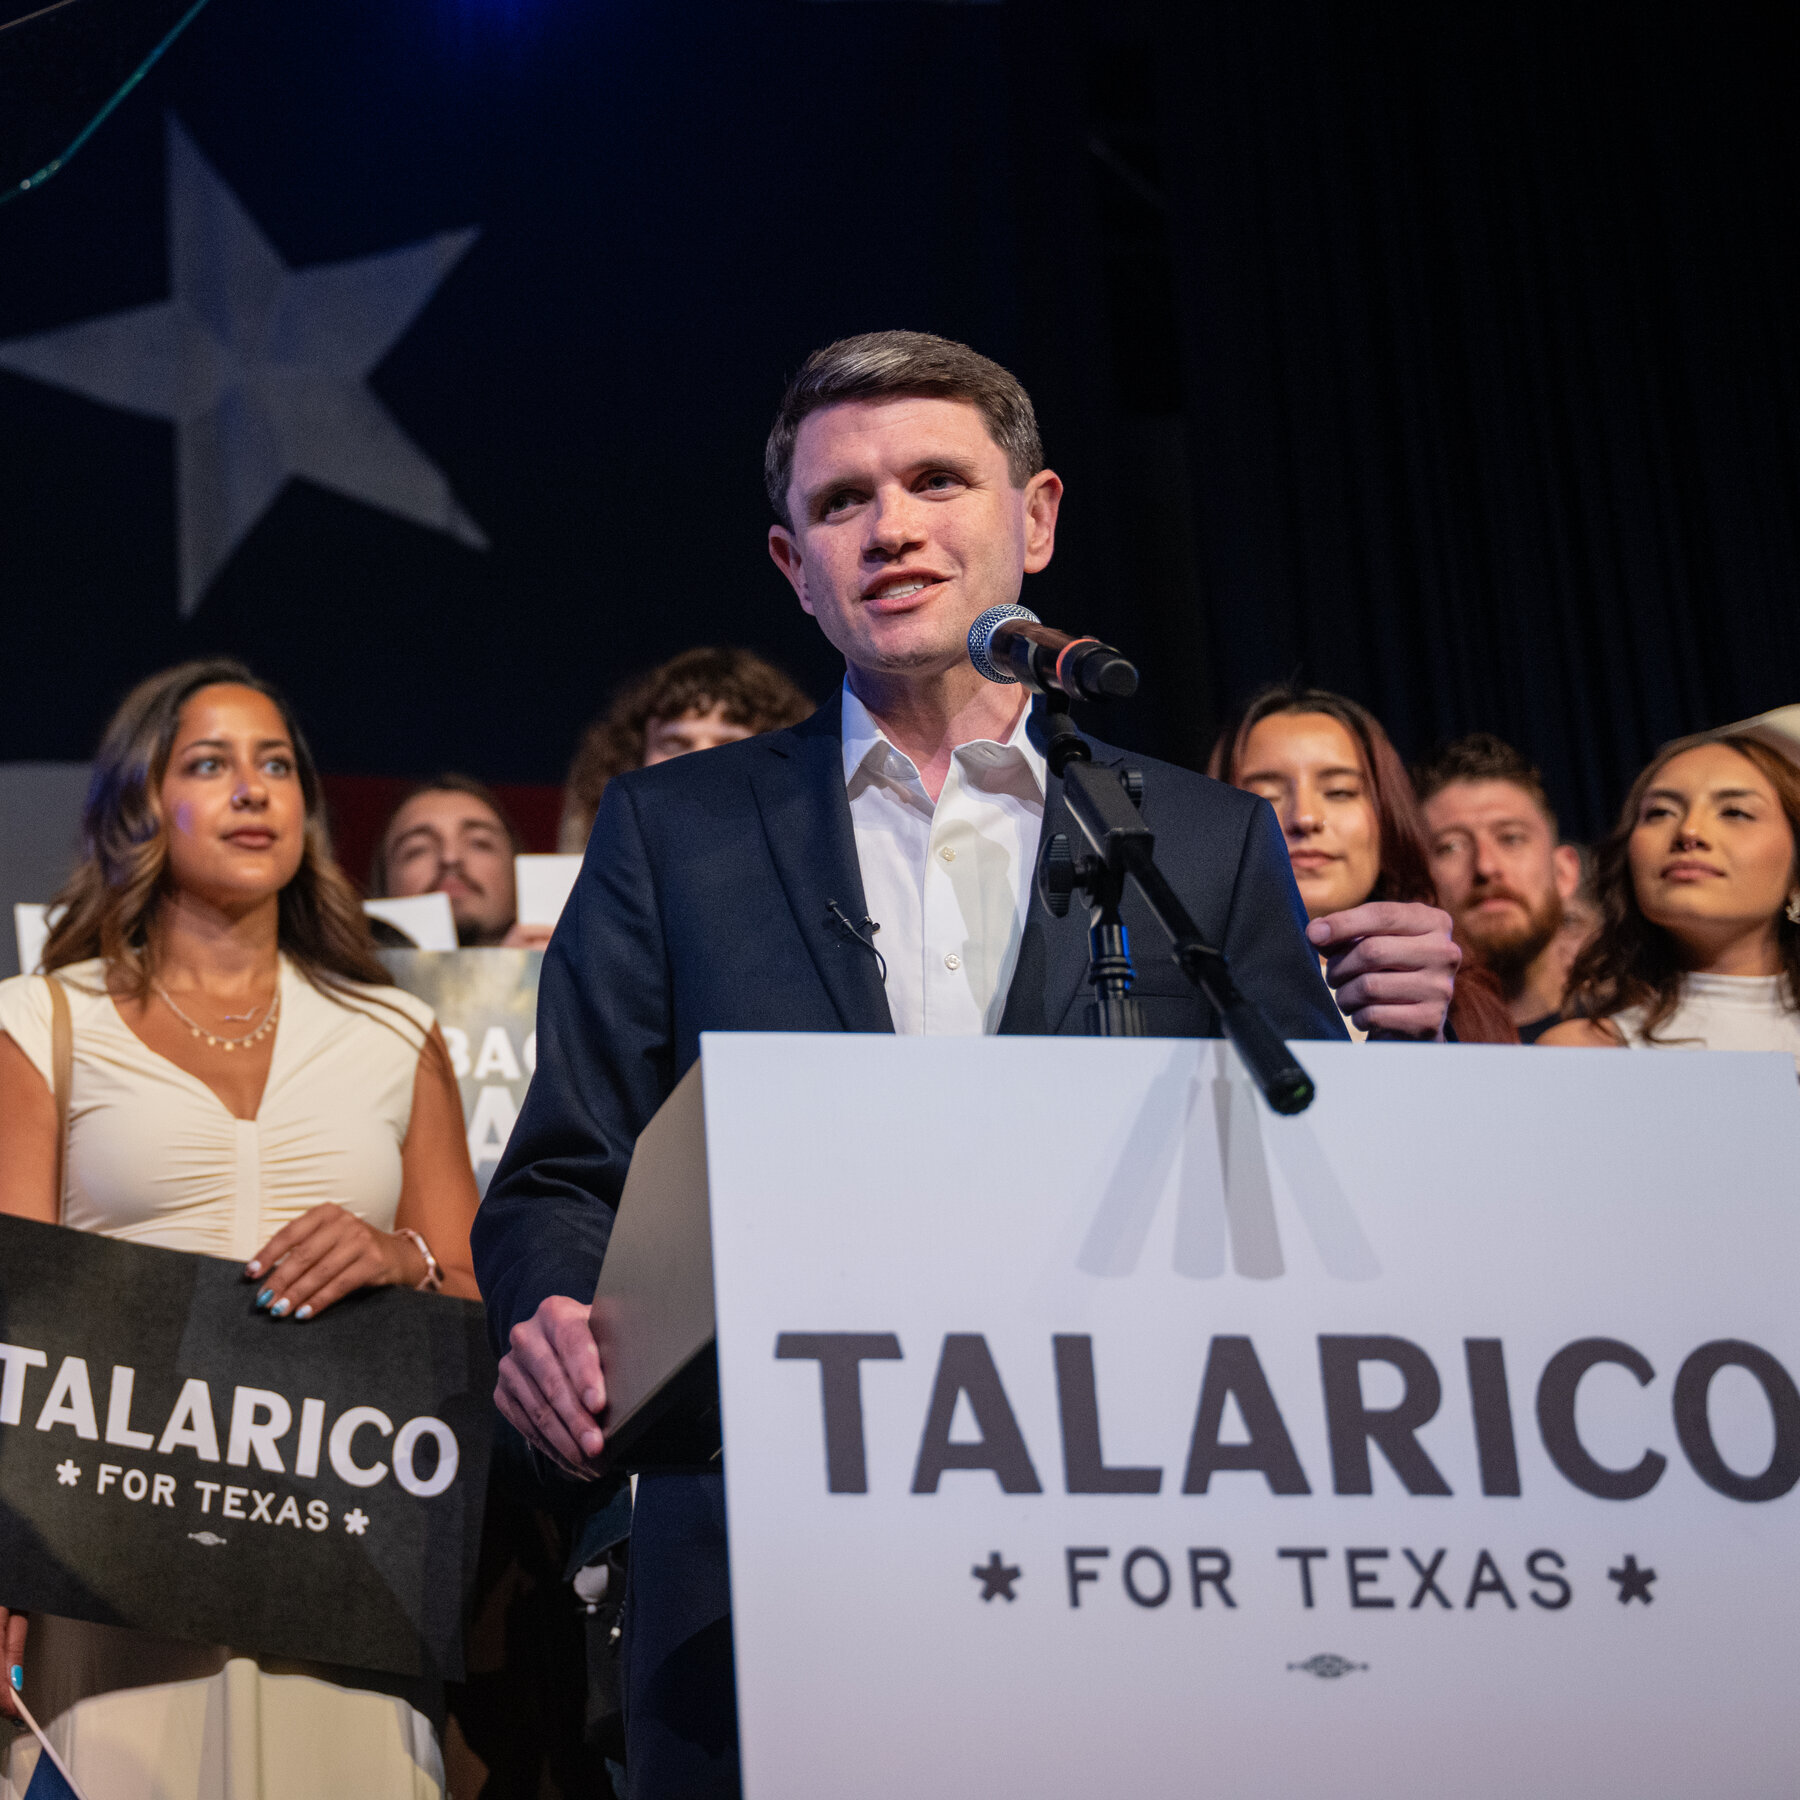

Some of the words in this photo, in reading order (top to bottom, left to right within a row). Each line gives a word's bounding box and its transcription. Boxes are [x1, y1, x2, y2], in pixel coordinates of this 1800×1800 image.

[0, 1342, 460, 1498] TALARICO
[774, 1332, 1800, 1505] TALARICO
[96, 1463, 178, 1508] FOR
[194, 1480, 330, 1533] TEXAS
[1065, 1546, 1238, 1610] FOR
[1277, 1546, 1574, 1612] TEXAS
